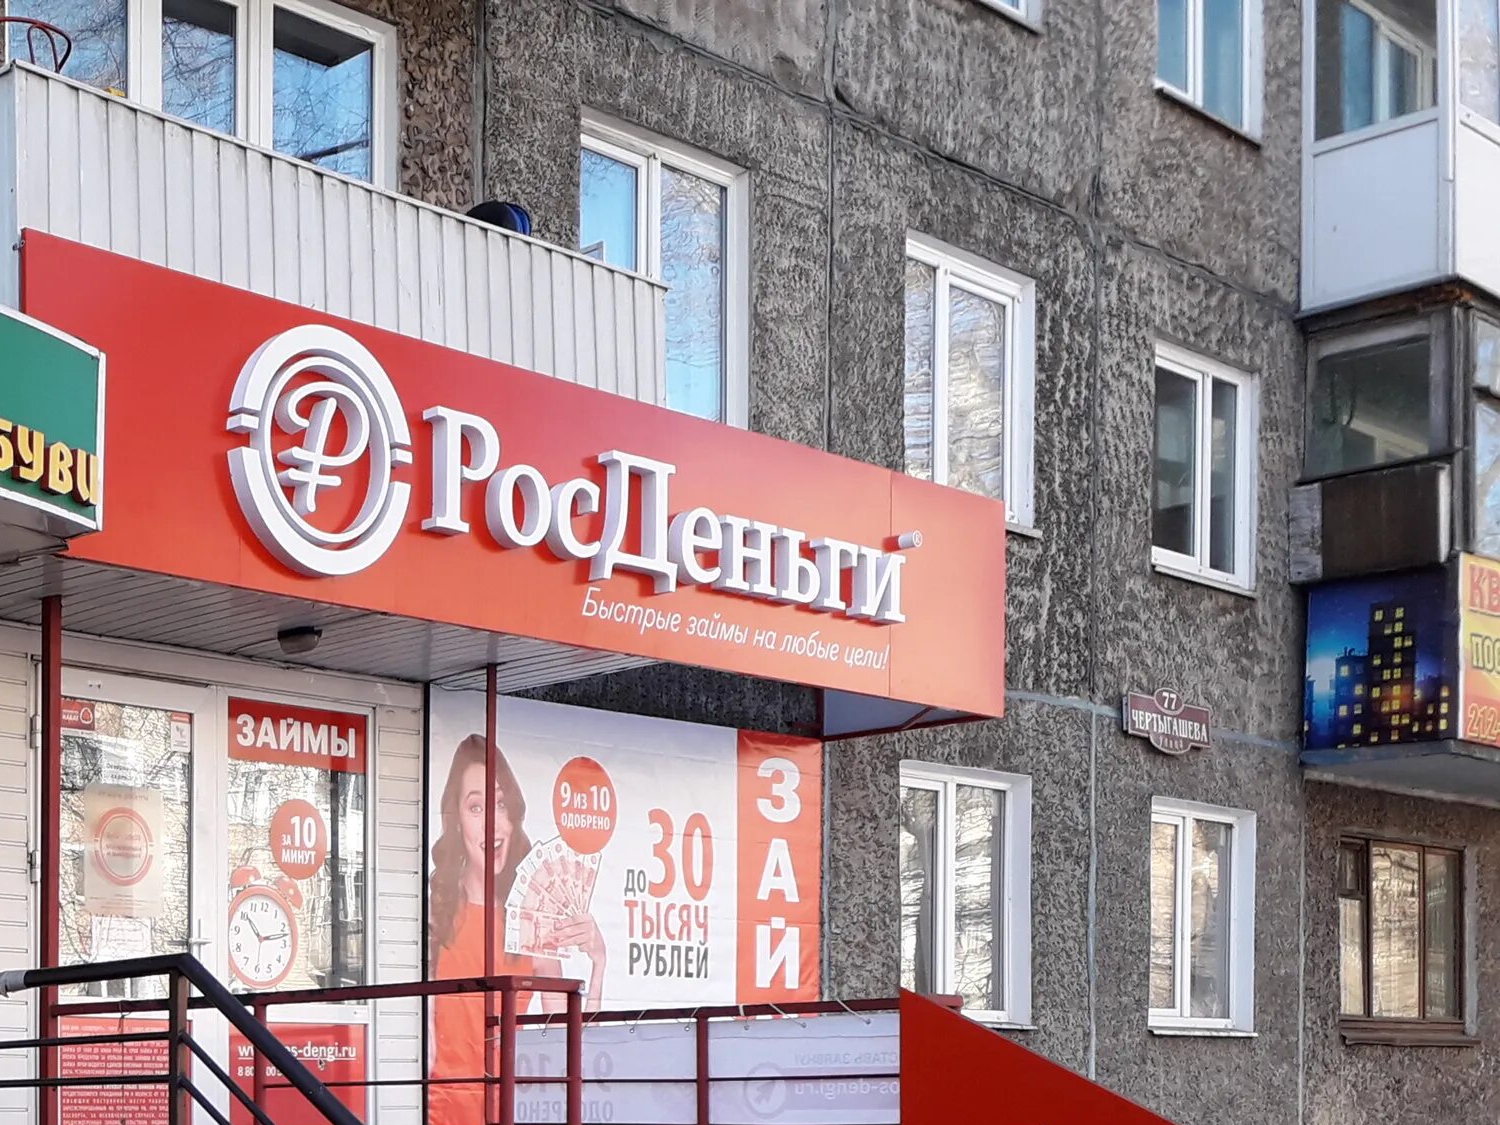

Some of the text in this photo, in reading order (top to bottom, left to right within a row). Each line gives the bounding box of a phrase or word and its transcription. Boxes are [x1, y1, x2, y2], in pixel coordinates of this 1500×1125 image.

[422, 404, 906, 625] РосДеньги
[582, 586, 890, 671] Быстрые займы на любые цели!
[1162, 691, 1177, 710] 77
[236, 712, 357, 759] ЗАЙМЫ
[1132, 709, 1208, 743] ЧЕРТЫГАШЕВА
[561, 782, 571, 807] 9
[590, 785, 610, 812] 10
[282, 815, 317, 848] ЗА 10
[561, 812, 610, 830] ОДОБРЕНО
[282, 848, 316, 865] МИНУТ
[647, 808, 714, 901] 30
[755, 757, 801, 990] ЗАЙ
[624, 900, 709, 942] ТЫСЯЧ
[629, 938, 709, 979] РУБЛЕЙ
